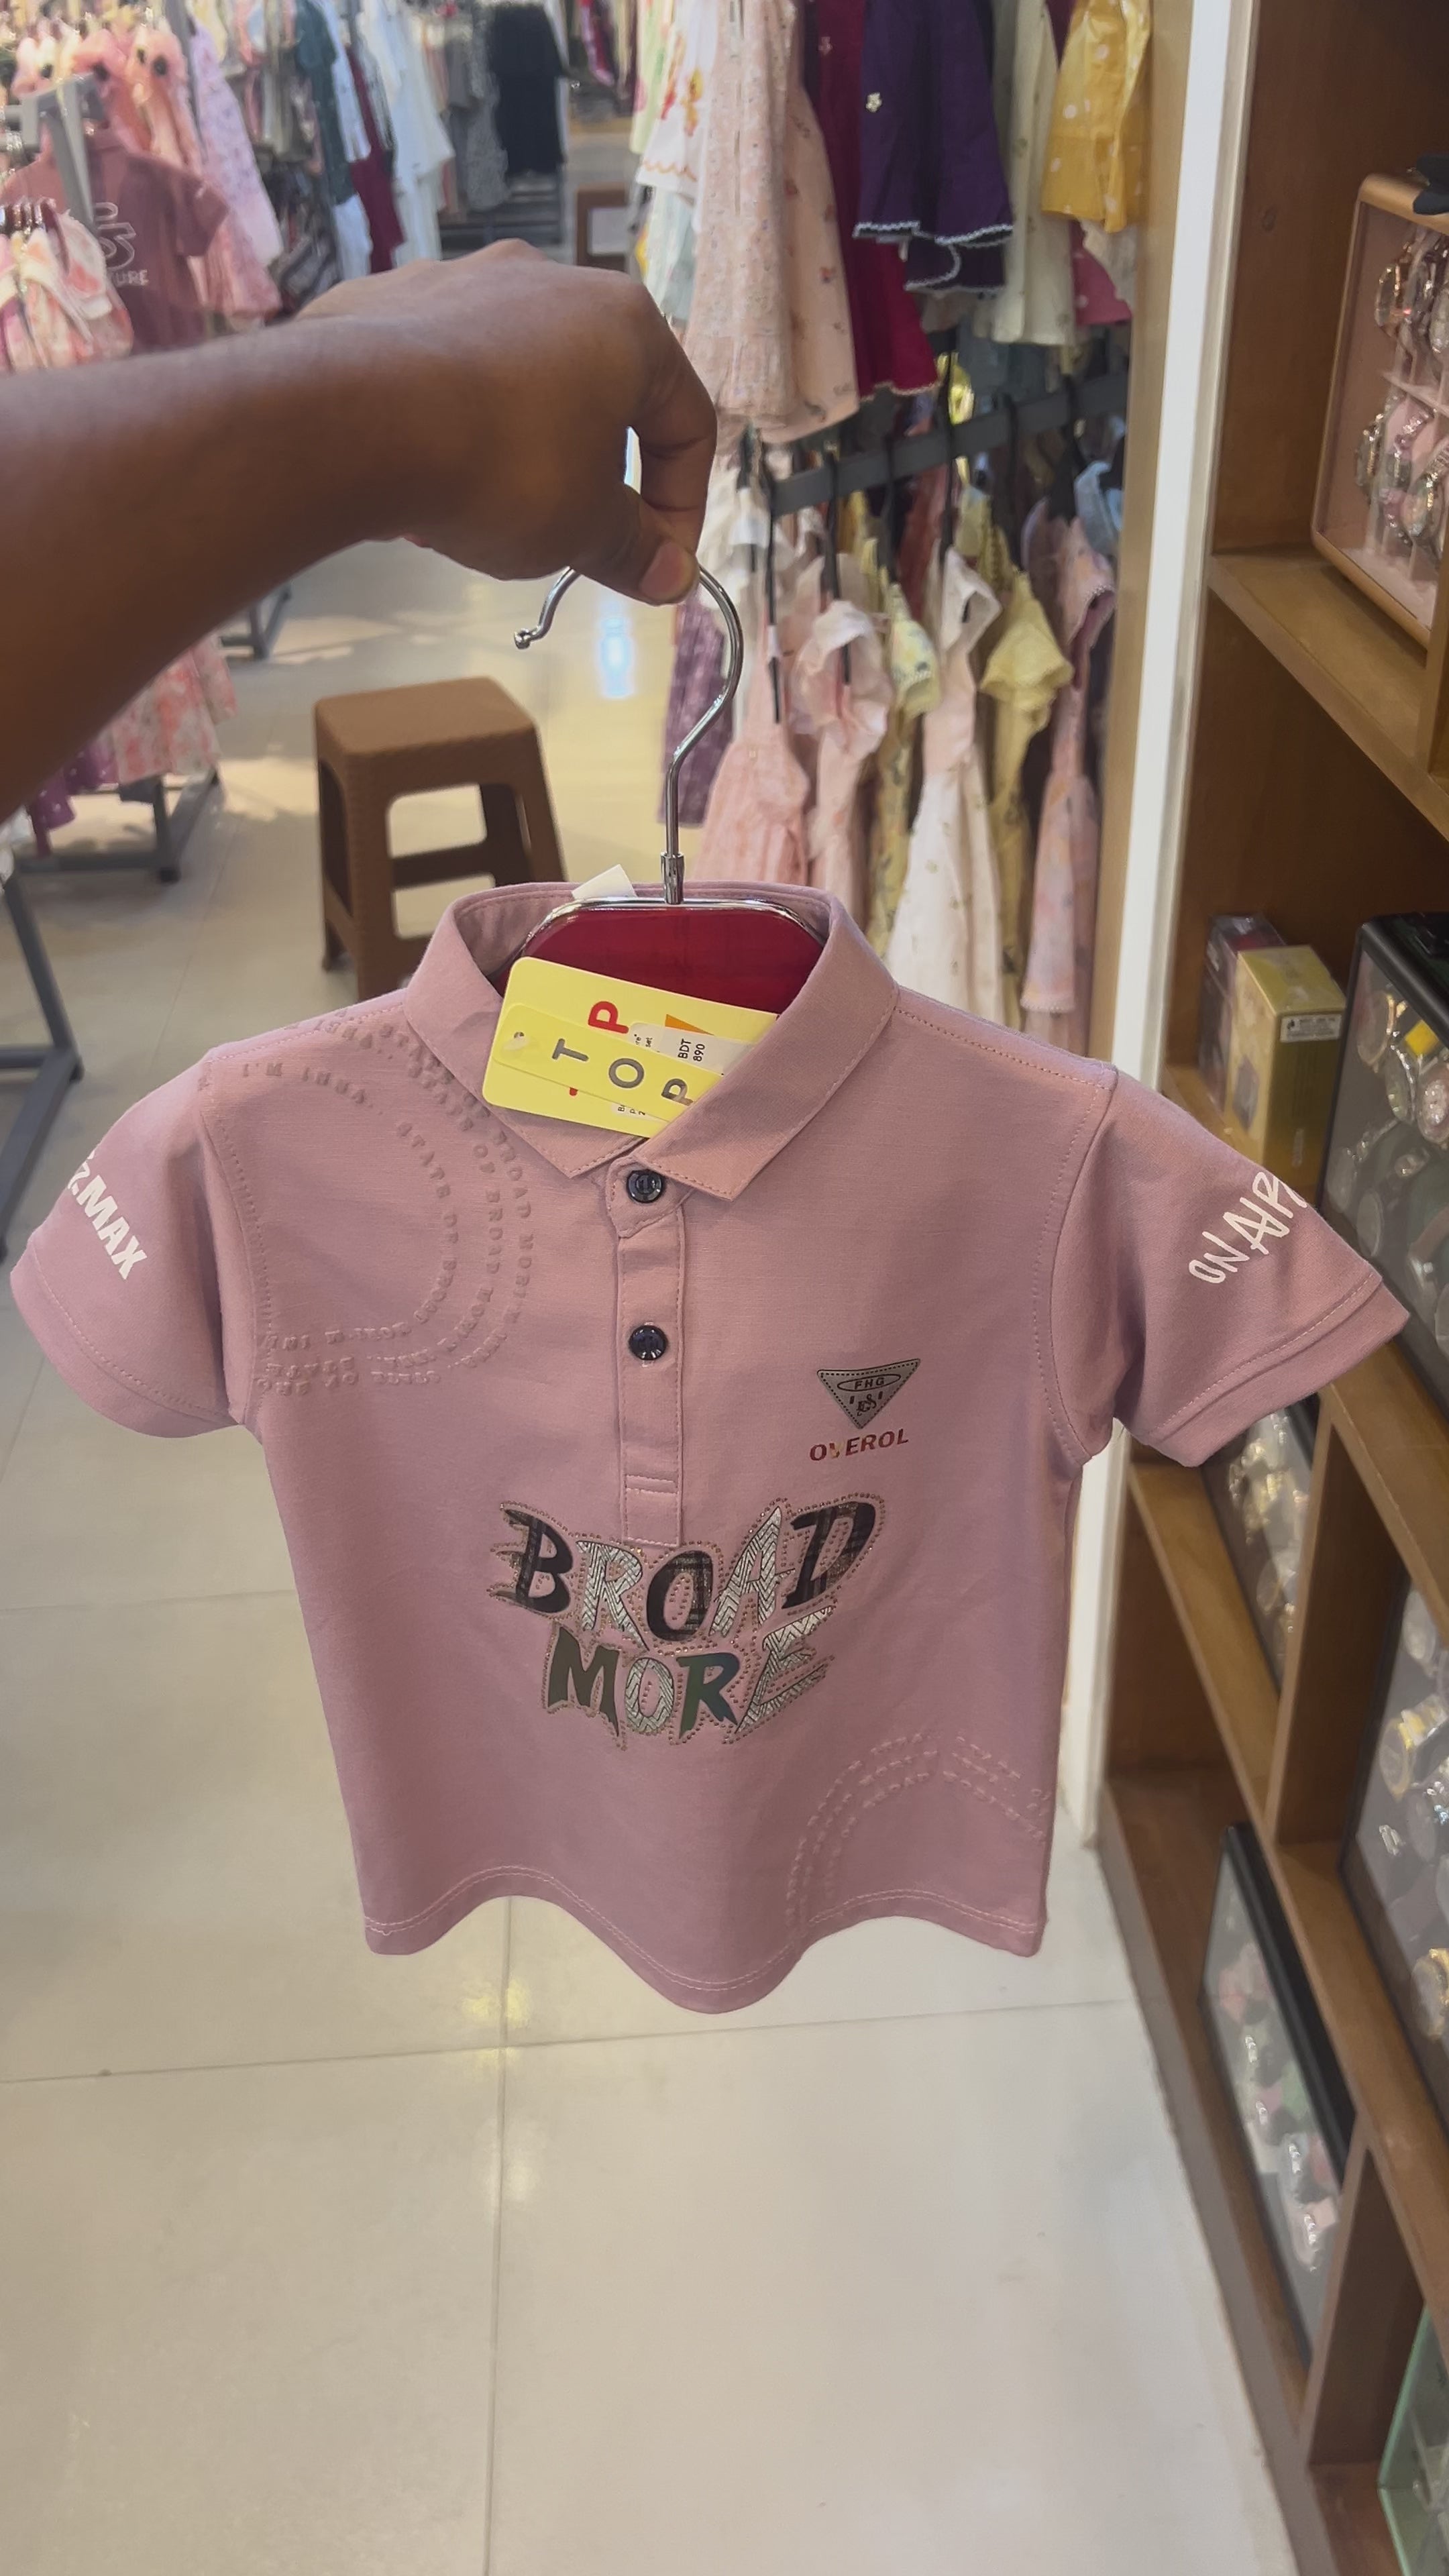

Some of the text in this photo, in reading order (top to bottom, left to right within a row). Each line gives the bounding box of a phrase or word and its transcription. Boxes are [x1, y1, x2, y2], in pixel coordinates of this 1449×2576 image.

[678, 1038, 692, 1059] BDT
[693, 1044, 706, 1062] 890
[1189, 1231, 1250, 1284] ON
[490, 1501, 876, 1652] BROAD
[547, 1606, 835, 1739] MORE
